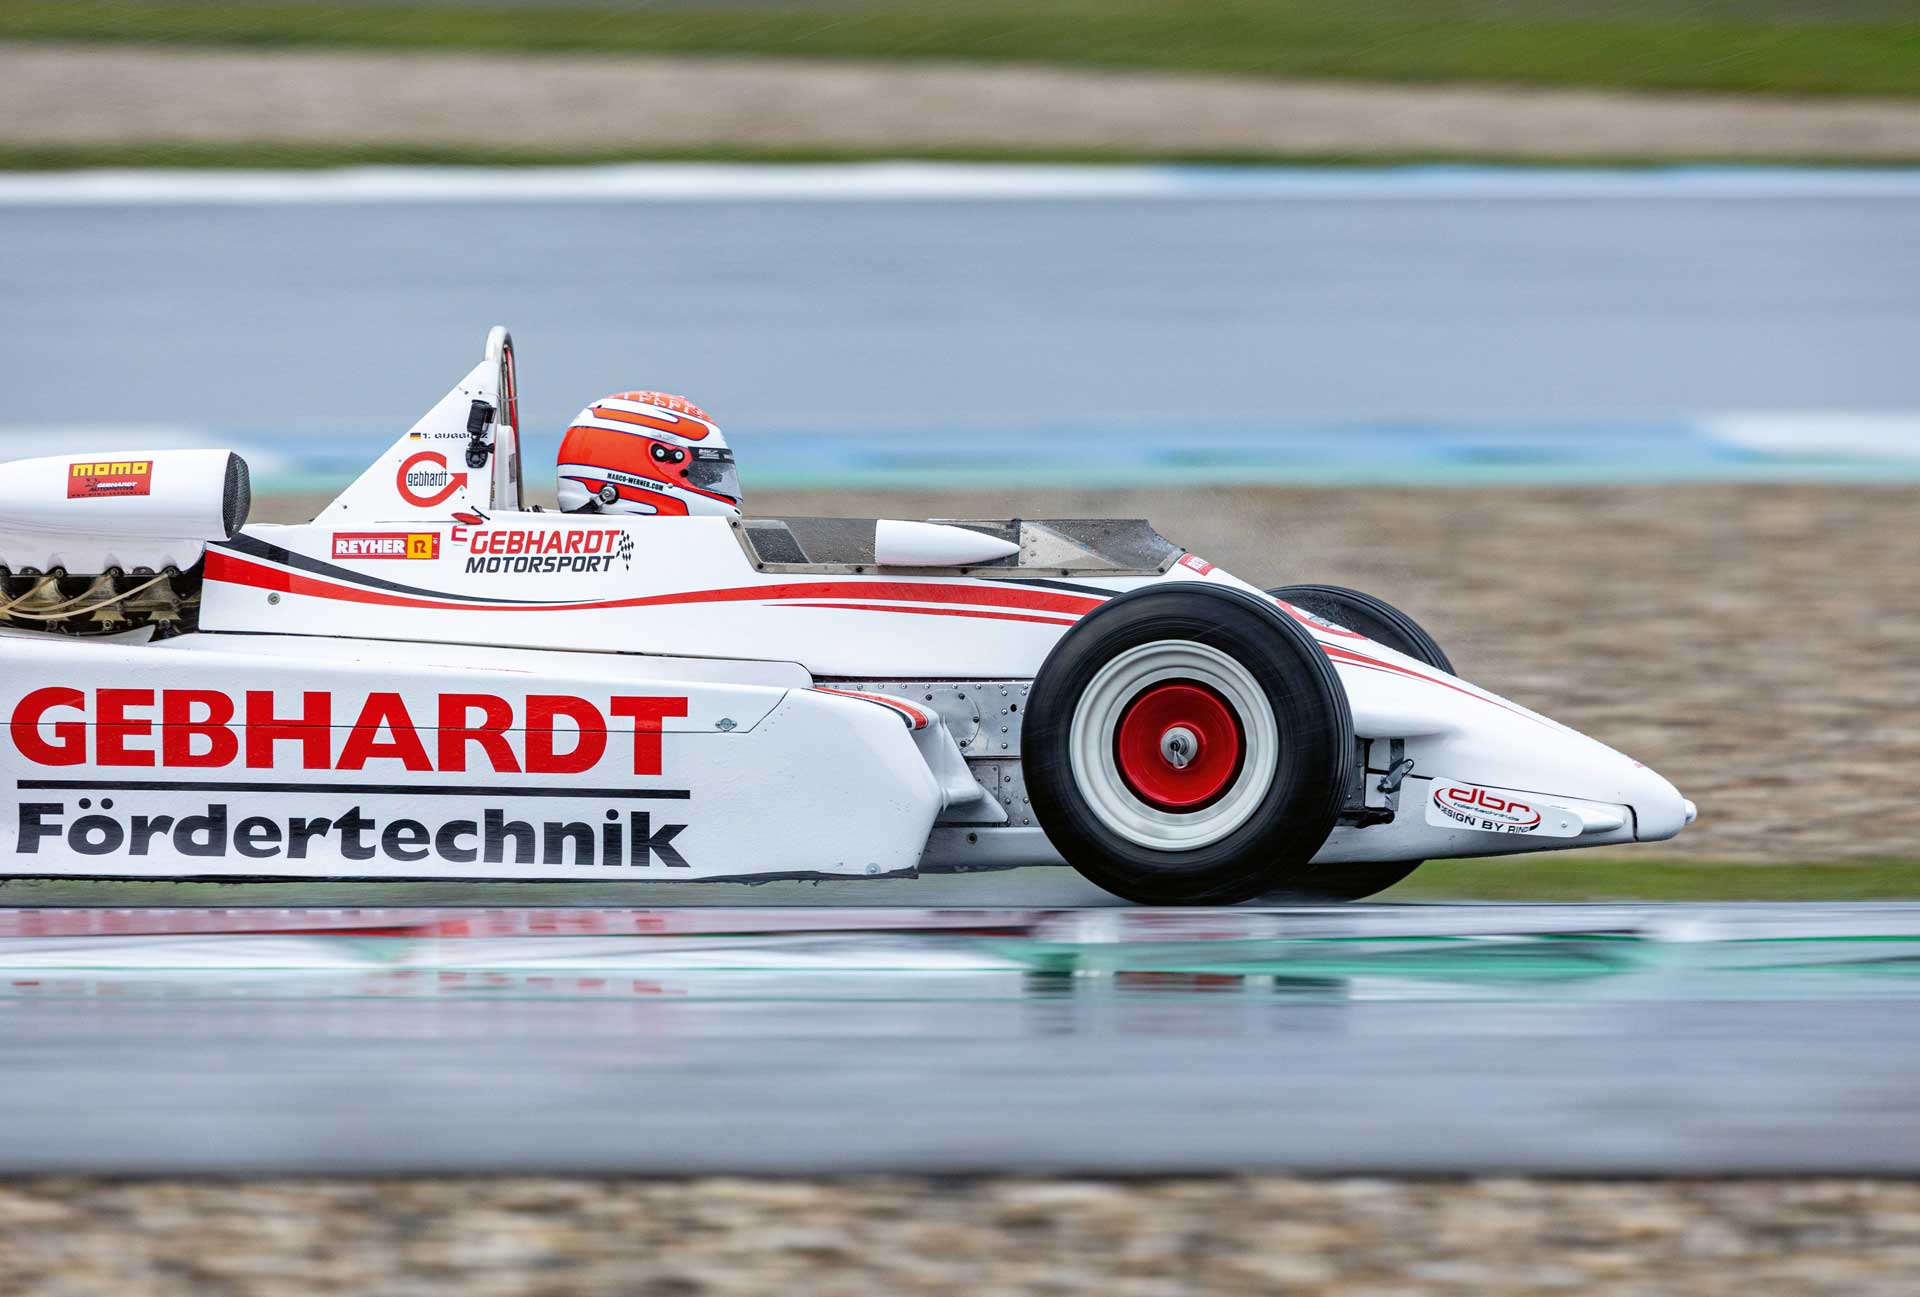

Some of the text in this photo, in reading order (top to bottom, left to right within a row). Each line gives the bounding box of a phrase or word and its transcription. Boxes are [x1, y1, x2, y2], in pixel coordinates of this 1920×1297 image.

[407, 470, 448, 487] gebhardt
[335, 539, 407, 555] REYHER
[469, 530, 621, 555] GEBHARDT
[464, 555, 616, 574] MOTORSPORT
[10, 686, 689, 776] GEBHARDT
[1448, 787, 1530, 813] dbr
[1440, 805, 1476, 826] DESIGN
[1481, 820, 1504, 832] BY
[15, 797, 691, 868] Fördertechnik
